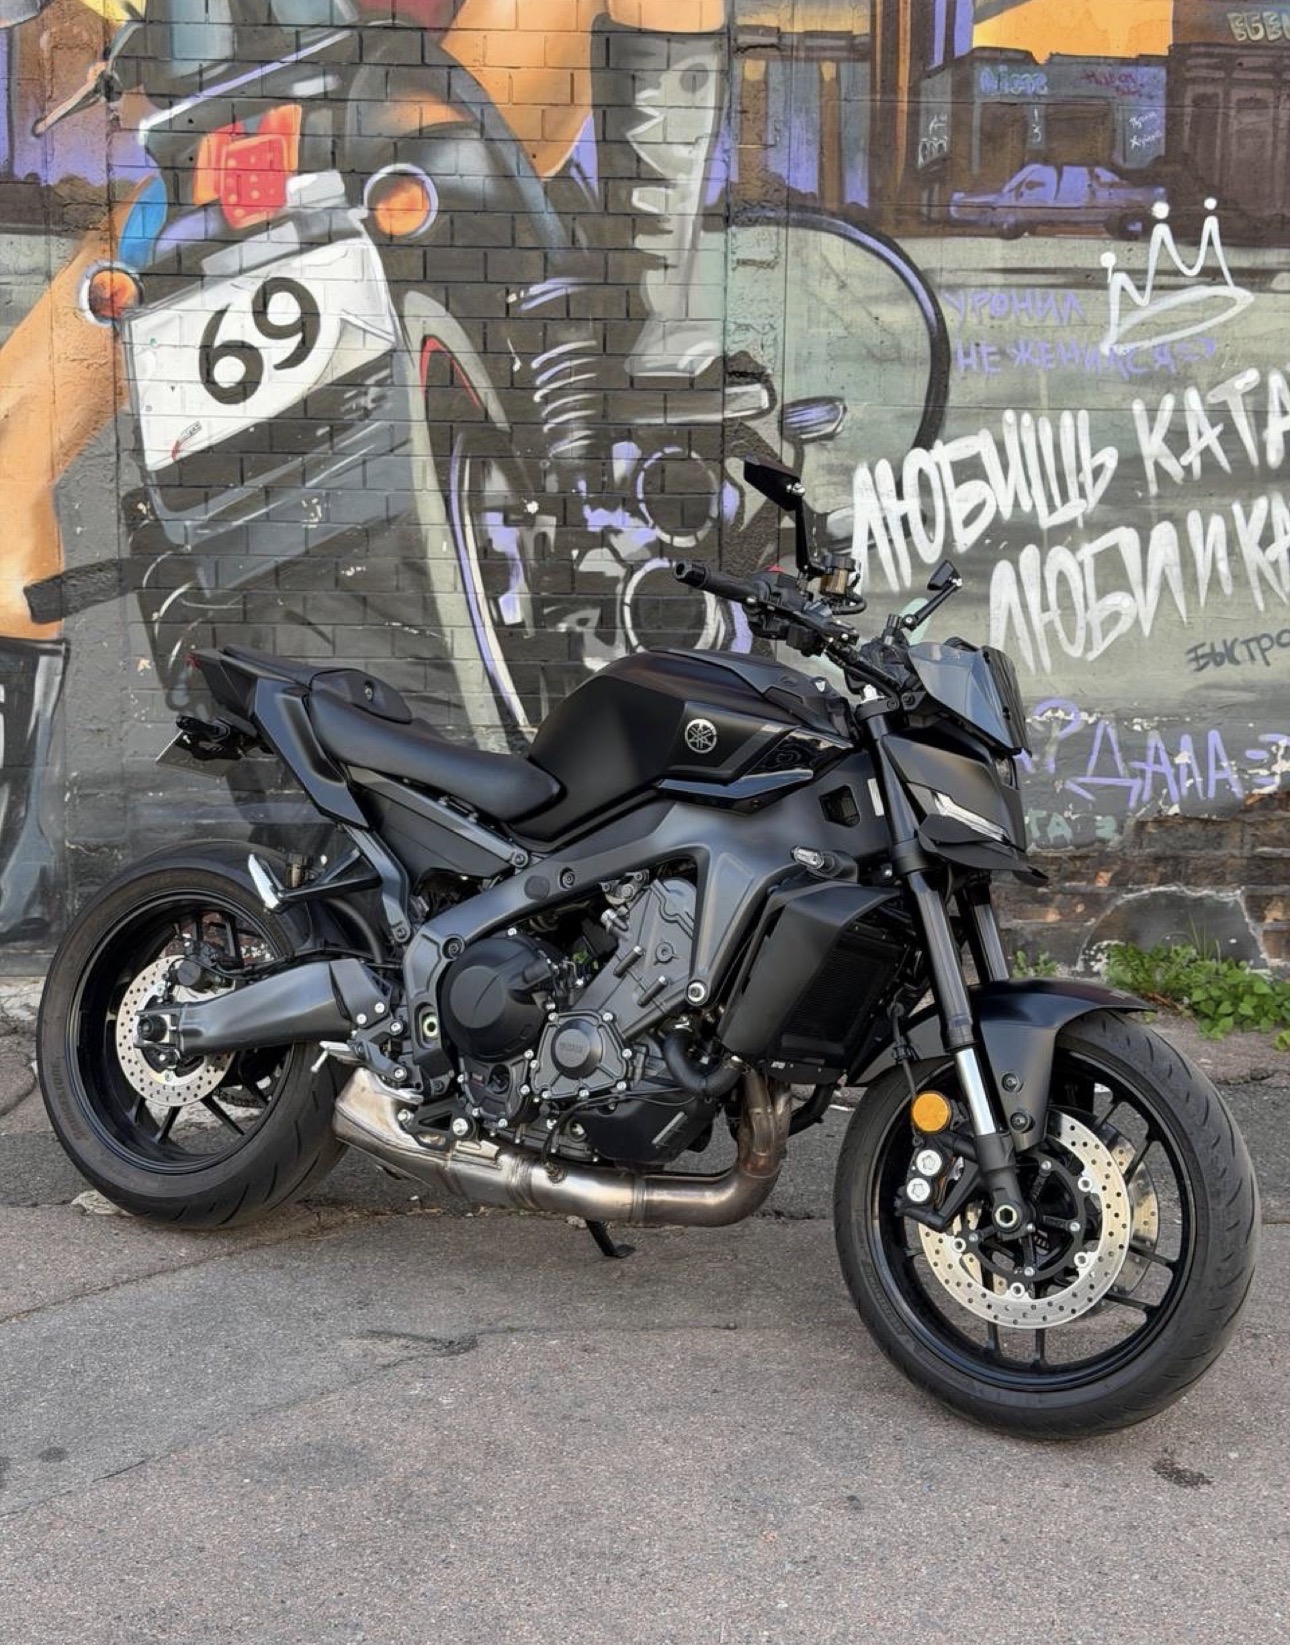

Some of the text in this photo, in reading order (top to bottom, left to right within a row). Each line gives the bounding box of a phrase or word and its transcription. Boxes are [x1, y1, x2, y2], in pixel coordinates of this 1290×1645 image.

[199, 277, 320, 404] 69
[941, 290, 1087, 329] УРОНИЛ
[956, 337, 1000, 376] НЕ
[988, 520, 1187, 675] ЛЮБИ
